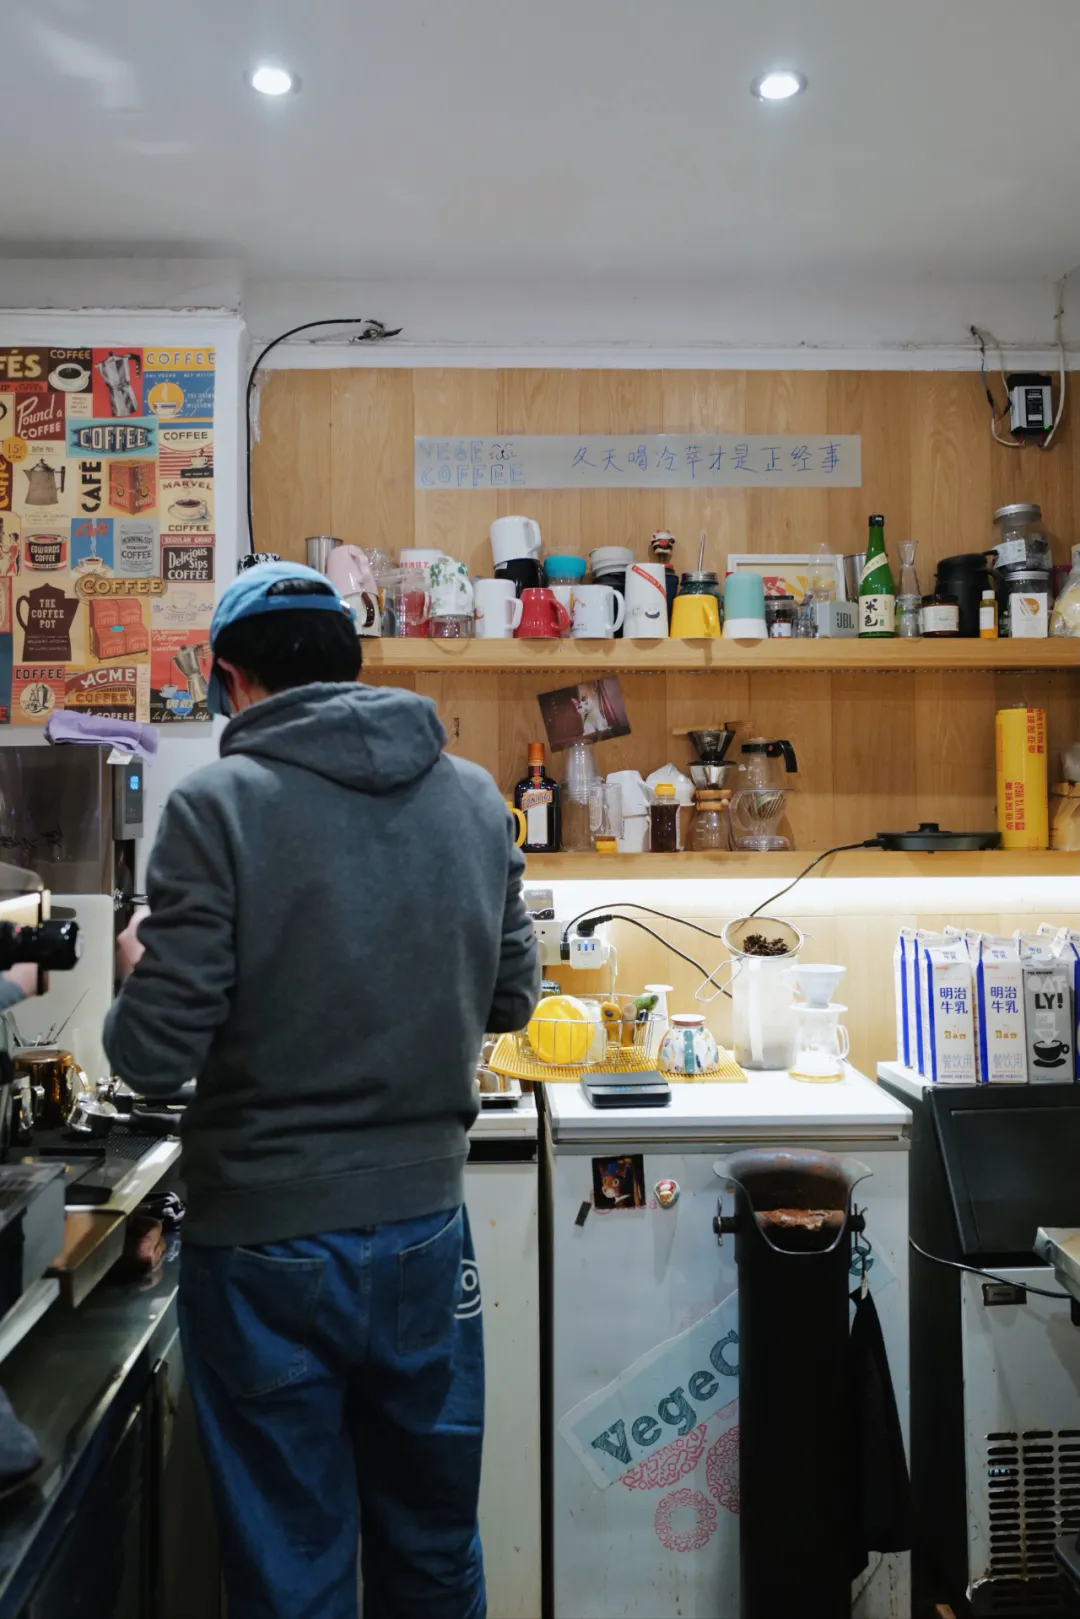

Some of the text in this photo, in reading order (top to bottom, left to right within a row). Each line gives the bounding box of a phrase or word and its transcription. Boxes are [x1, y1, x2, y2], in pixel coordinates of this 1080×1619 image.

[50, 350, 91, 359] COFFEE
[146, 353, 215, 365] COFFEE
[17, 394, 55, 434] Pound
[20, 422, 61, 439] COFFEE
[163, 432, 208, 440] COFFEE
[80, 427, 147, 450] COFFEE
[421, 464, 525, 487] COFFEE
[79, 461, 102, 513] CAFÉ
[162, 480, 212, 490] MARVEL
[168, 524, 209, 532] COFFEE
[35, 554, 55, 562] COFFEE
[121, 550, 152, 559] COFFEE
[168, 548, 208, 569] Delicious
[167, 570, 208, 580] COFFEE
[82, 577, 163, 594] COFFEE
[40, 599, 56, 608] THE
[31, 610, 64, 618] COFFEE
[837, 612, 854, 629] JBL
[40, 620, 56, 628] POT
[16, 669, 62, 679] COFFEE
[81, 669, 135, 688] ACME
[76, 693, 130, 703] COFFEE
[940, 986, 967, 1000] 明治
[990, 986, 1017, 999] 明治
[1034, 992, 1063, 1009] LY!
[940, 1001, 968, 1014] 牛乳
[991, 1001, 1018, 1014] 牛乳
